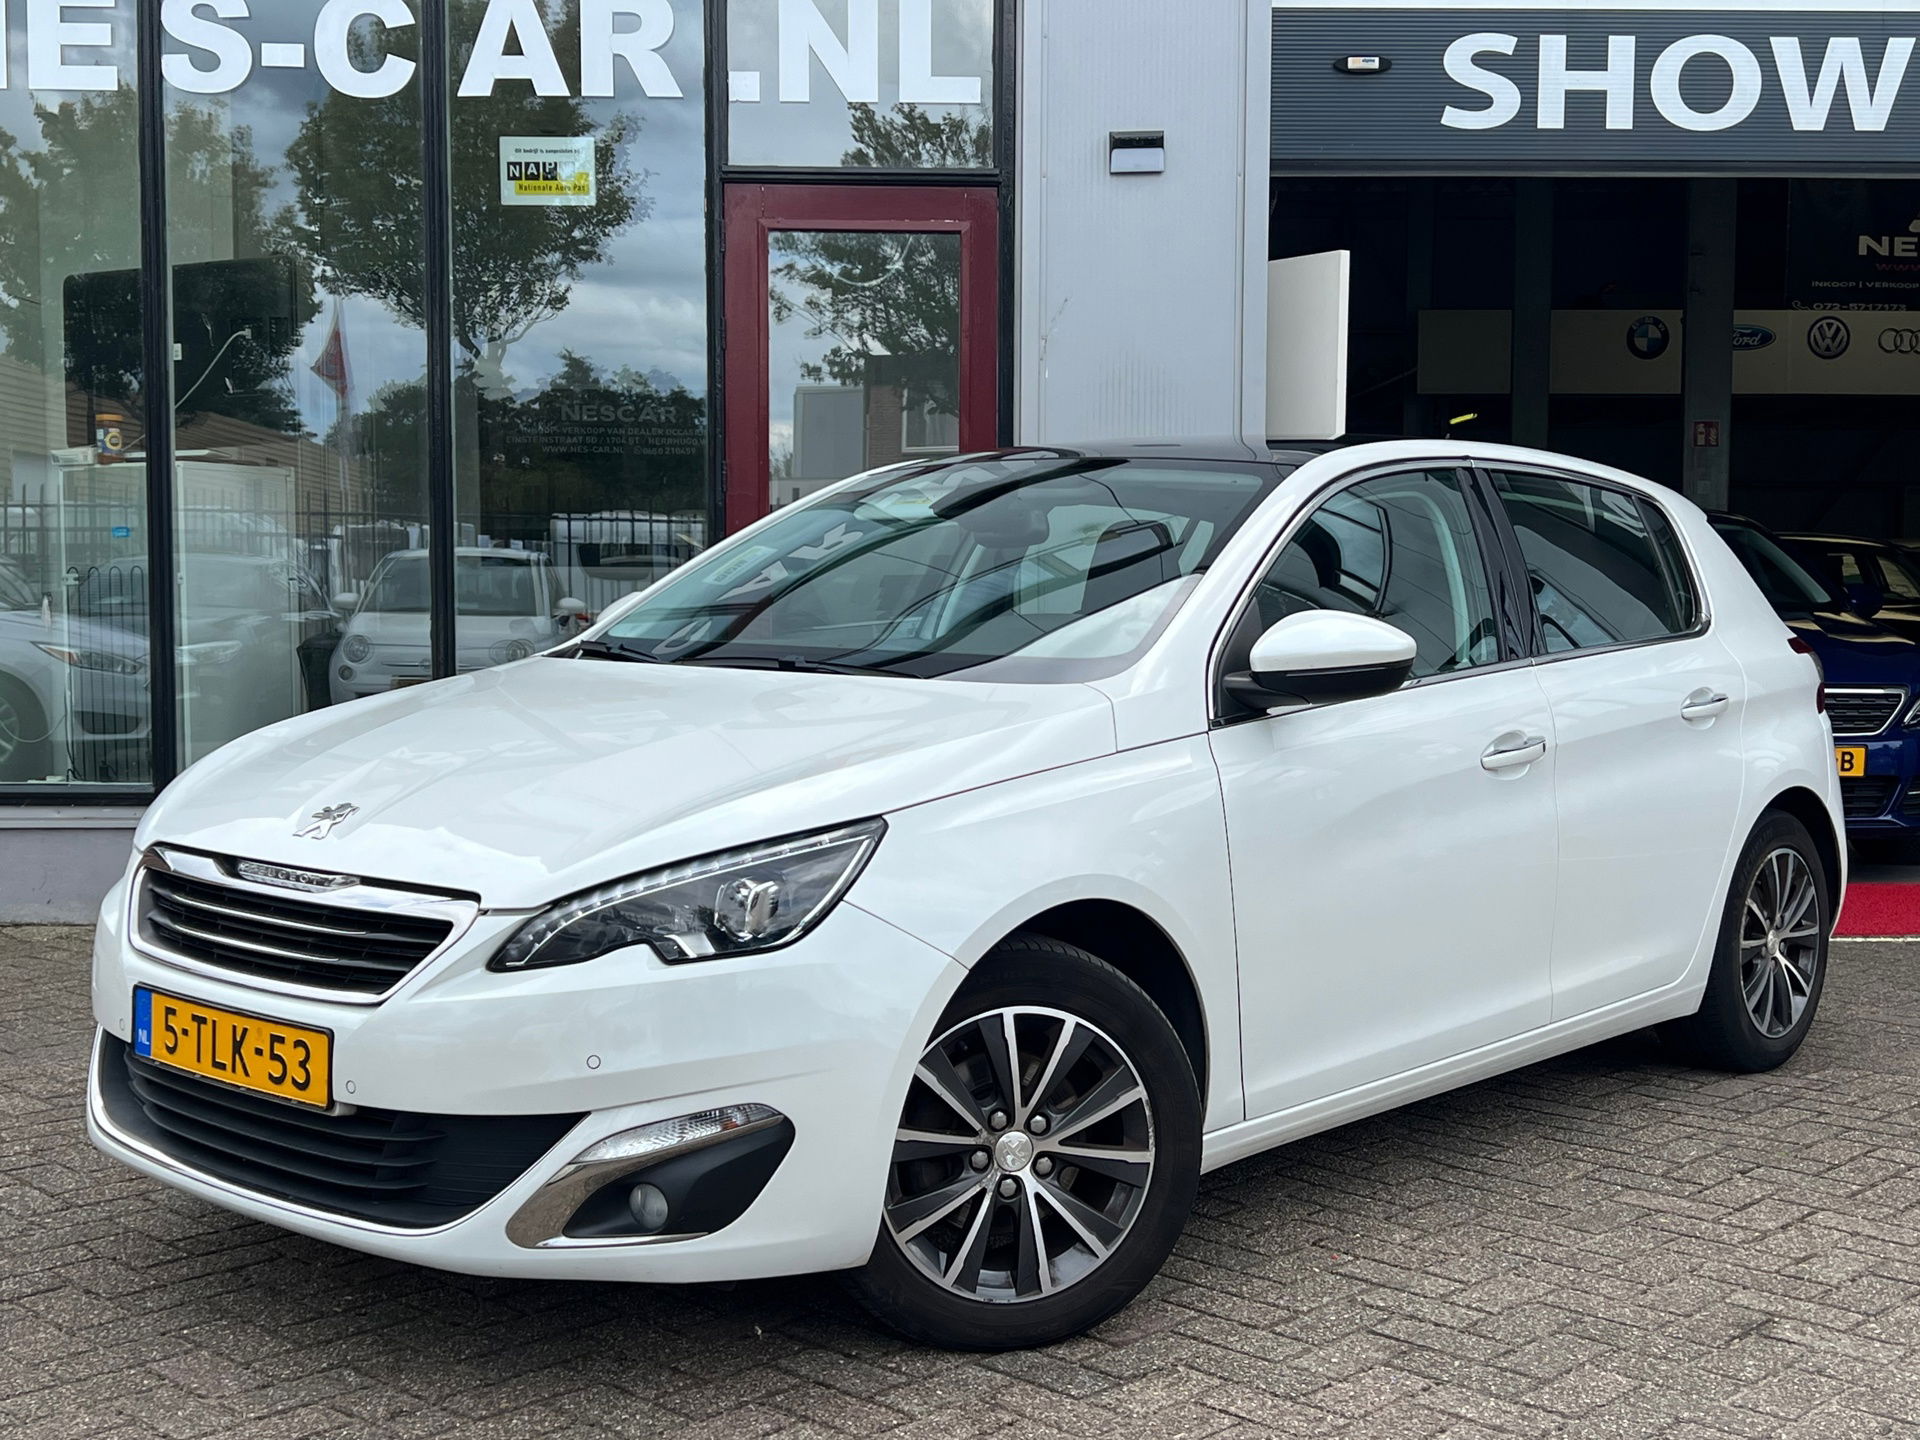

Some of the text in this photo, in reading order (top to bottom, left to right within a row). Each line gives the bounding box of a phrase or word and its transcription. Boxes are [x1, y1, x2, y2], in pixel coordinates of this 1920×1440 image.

[0, 0, 983, 104] ES-CAR.NL
[1440, 32, 1918, 132] SHOW
[518, 183, 553, 192] Nationale
[1858, 235, 1919, 257] NE
[1865, 281, 1920, 289] VERKOOP
[560, 403, 678, 424] NESCAR
[607, 427, 626, 435] VAN
[628, 427, 664, 436] DEALER
[138, 1028, 150, 1046] NL
[164, 1006, 312, 1092] 5-TLK-53
